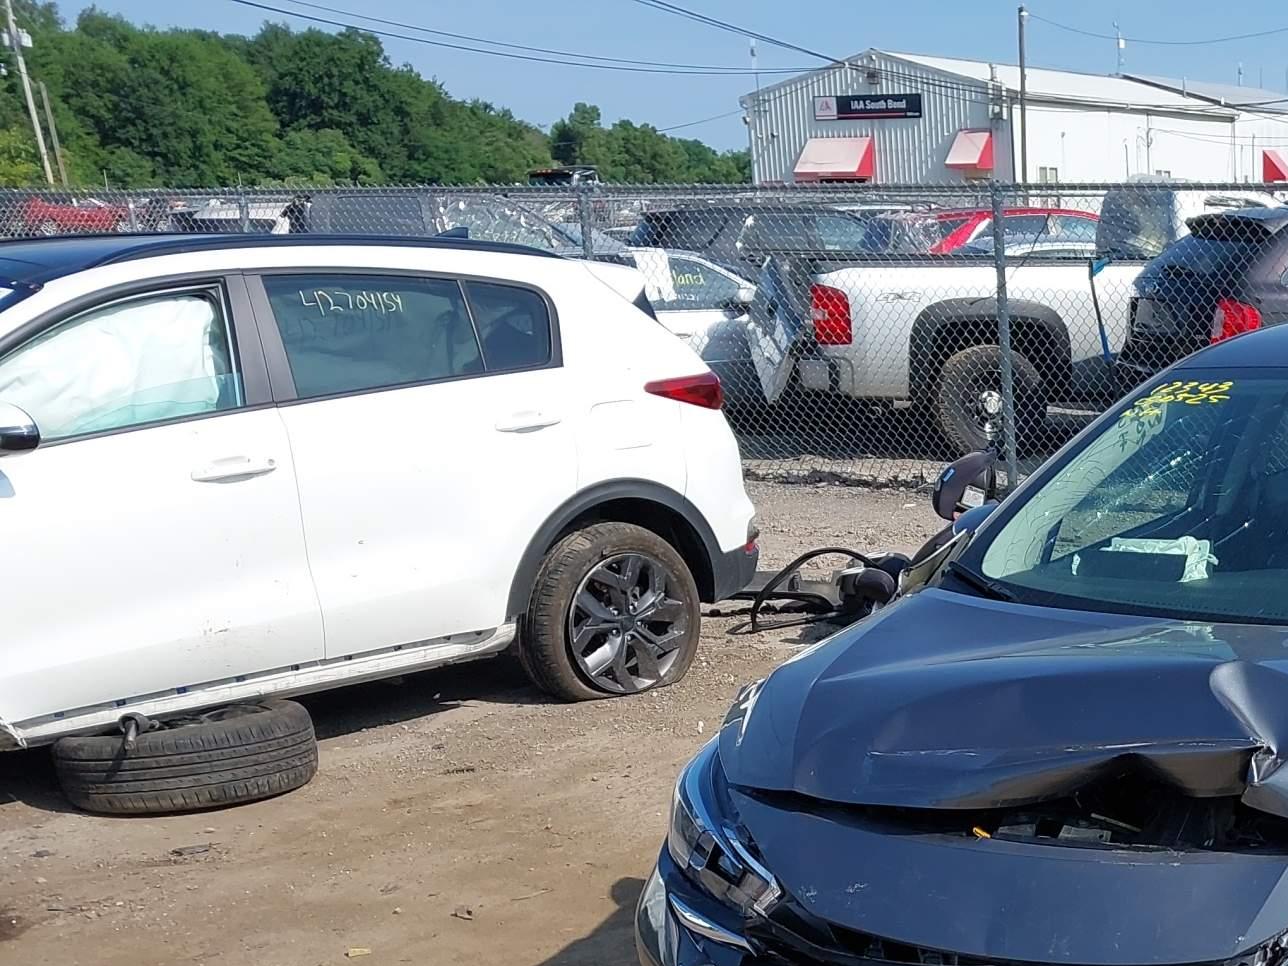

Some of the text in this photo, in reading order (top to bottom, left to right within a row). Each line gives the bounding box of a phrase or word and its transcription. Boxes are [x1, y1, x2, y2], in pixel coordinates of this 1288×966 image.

[850, 99, 906, 110] IAA South Bend
[299, 290, 404, 317] 42704154
